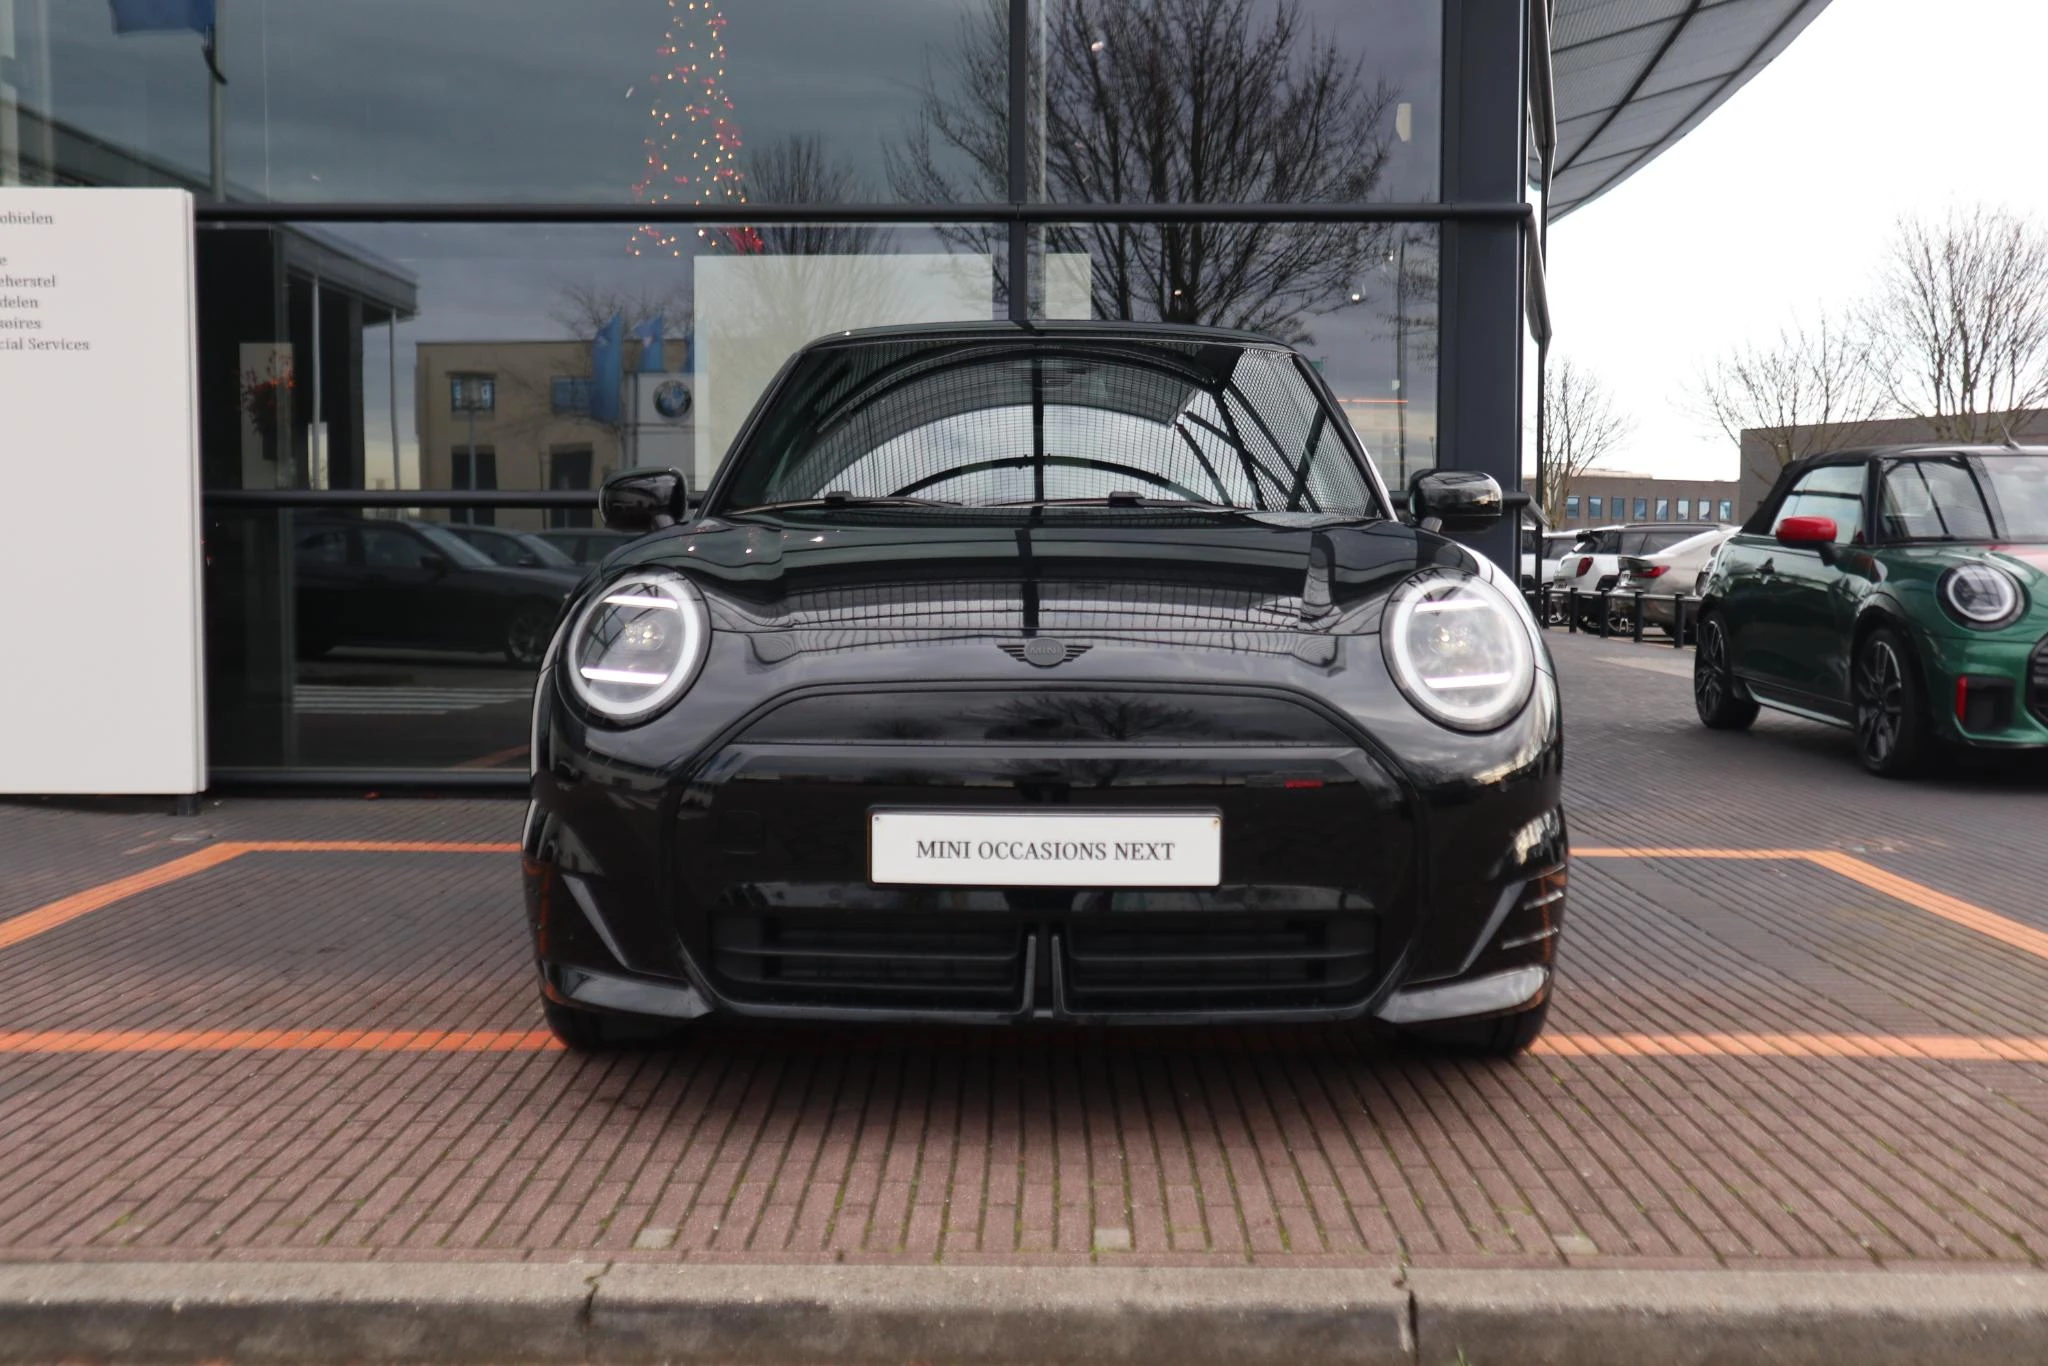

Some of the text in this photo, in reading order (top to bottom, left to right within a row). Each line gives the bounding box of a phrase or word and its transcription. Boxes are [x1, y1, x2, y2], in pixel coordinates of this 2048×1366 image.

[28, 336, 90, 350] Services
[916, 840, 1175, 861] MINI OCCASIONS NEXT
